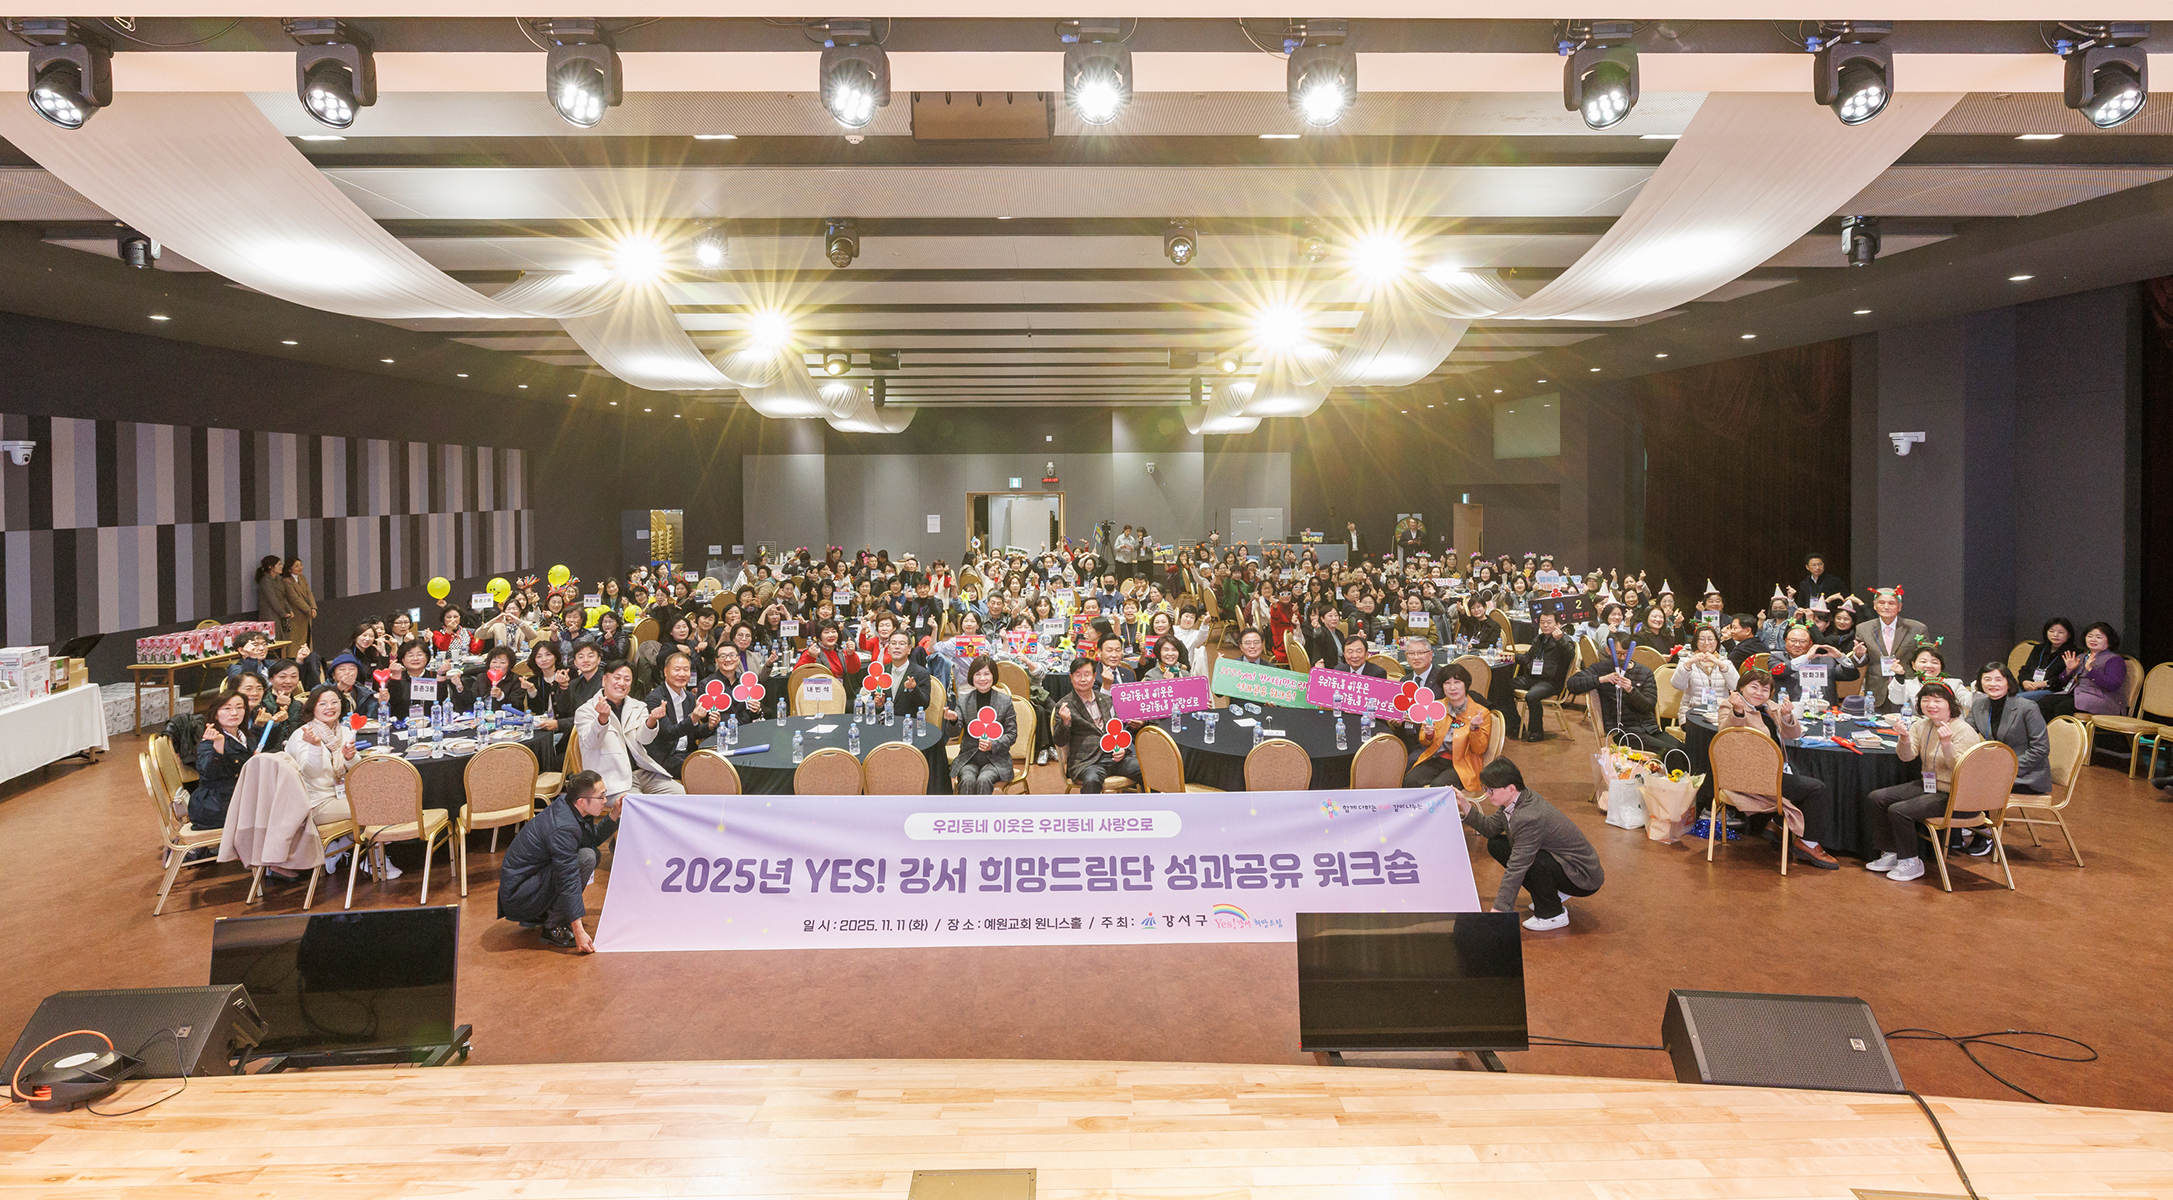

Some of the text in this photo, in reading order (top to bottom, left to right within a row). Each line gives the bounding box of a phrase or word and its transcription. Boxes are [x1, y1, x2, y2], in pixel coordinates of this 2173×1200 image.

[413, 684, 435, 693] 등촌3동
[1318, 675, 1346, 690] 우리동네
[1120, 688, 1149, 702] 우리동네
[1140, 699, 1169, 713] 우리동네
[932, 817, 1154, 834] 우리동네 이웃은 우리동네 사랑으로
[660, 848, 1420, 894] 2025년 YES! 강서 희망드림단 성과공유 워크숍
[984, 917, 1031, 931] 예원교회
[1034, 917, 1082, 930] 원니스홀
